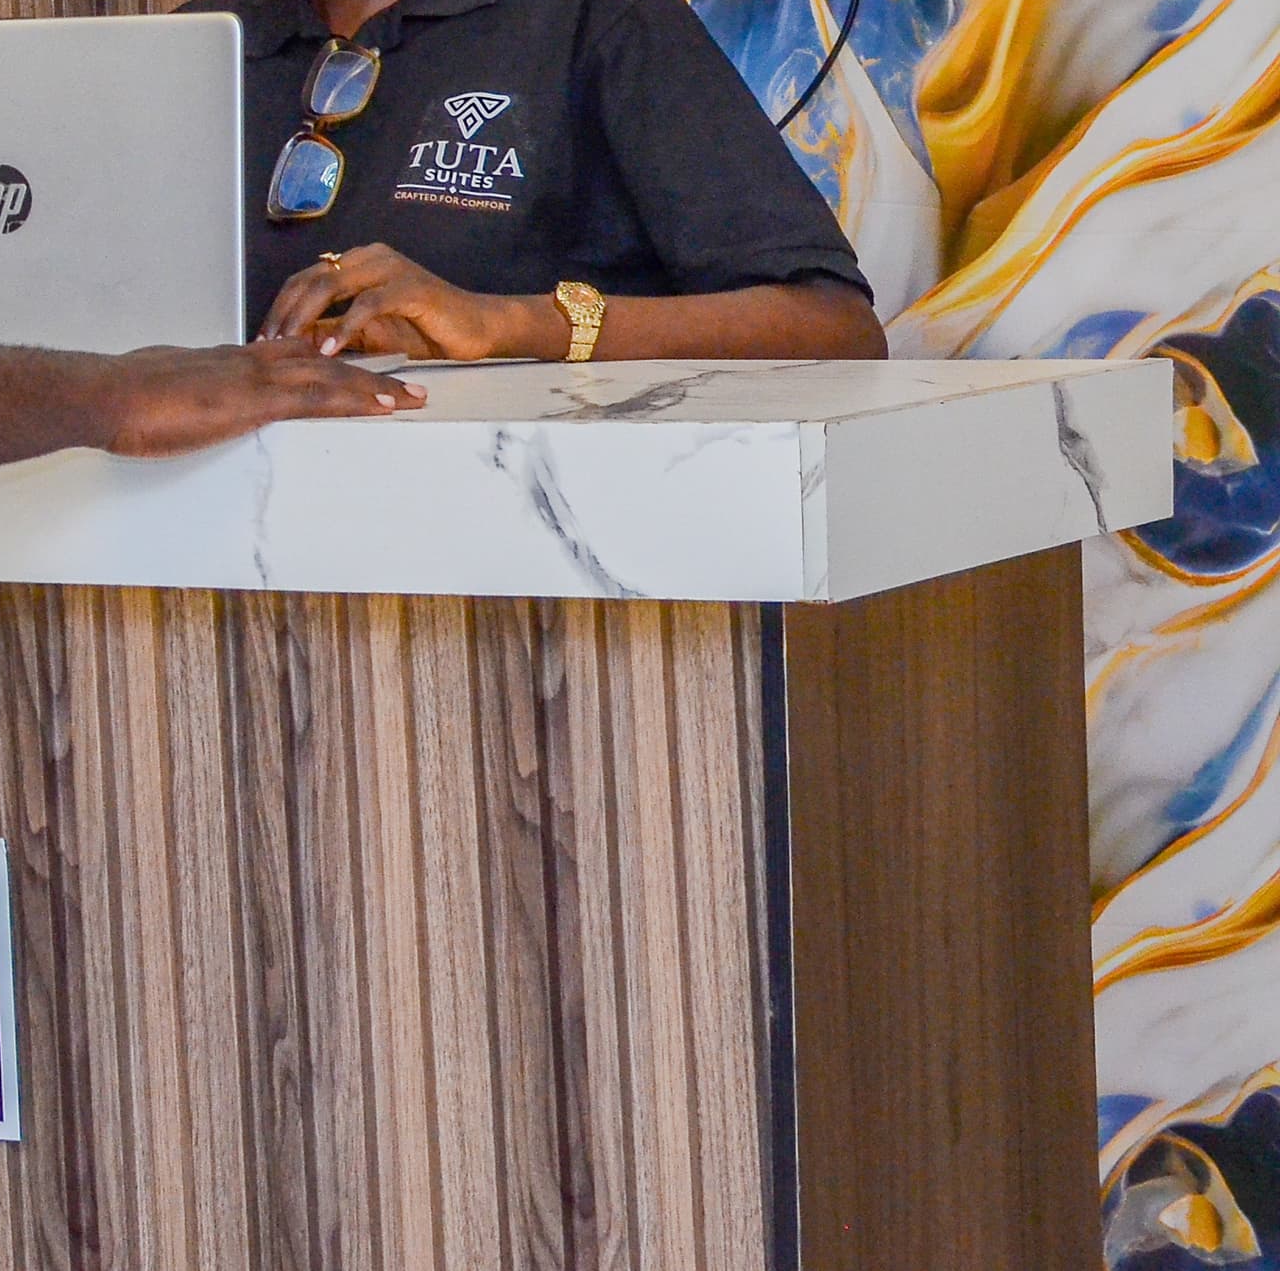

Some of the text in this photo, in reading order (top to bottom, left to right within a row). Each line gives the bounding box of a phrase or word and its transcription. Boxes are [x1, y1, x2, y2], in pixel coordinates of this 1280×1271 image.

[408, 139, 525, 178] TUTA
[424, 168, 494, 189] SUITES
[394, 191, 512, 212] CRAFTED FOR COMFORT
